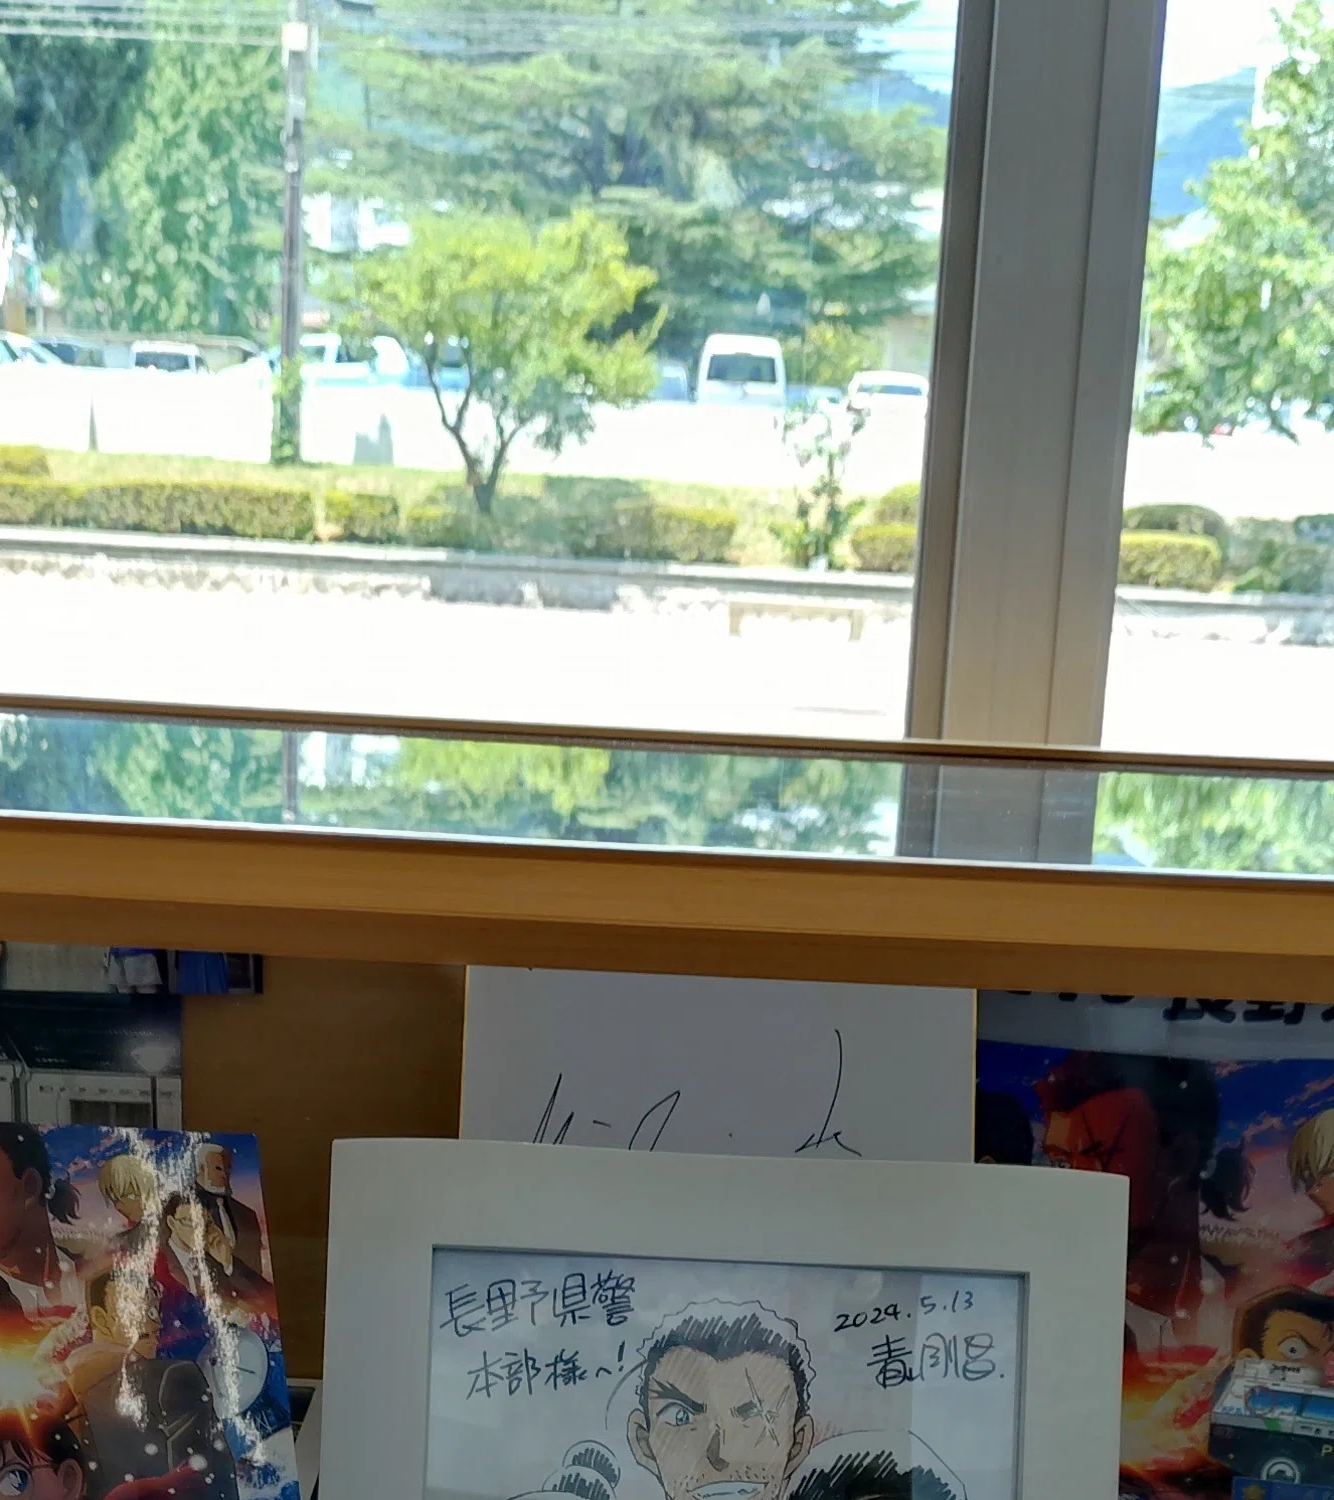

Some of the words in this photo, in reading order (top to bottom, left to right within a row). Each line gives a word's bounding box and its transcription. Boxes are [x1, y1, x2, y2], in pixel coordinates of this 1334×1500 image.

[439, 1268, 637, 1338] 長野県警
[833, 1290, 975, 1333] 2024.5.13
